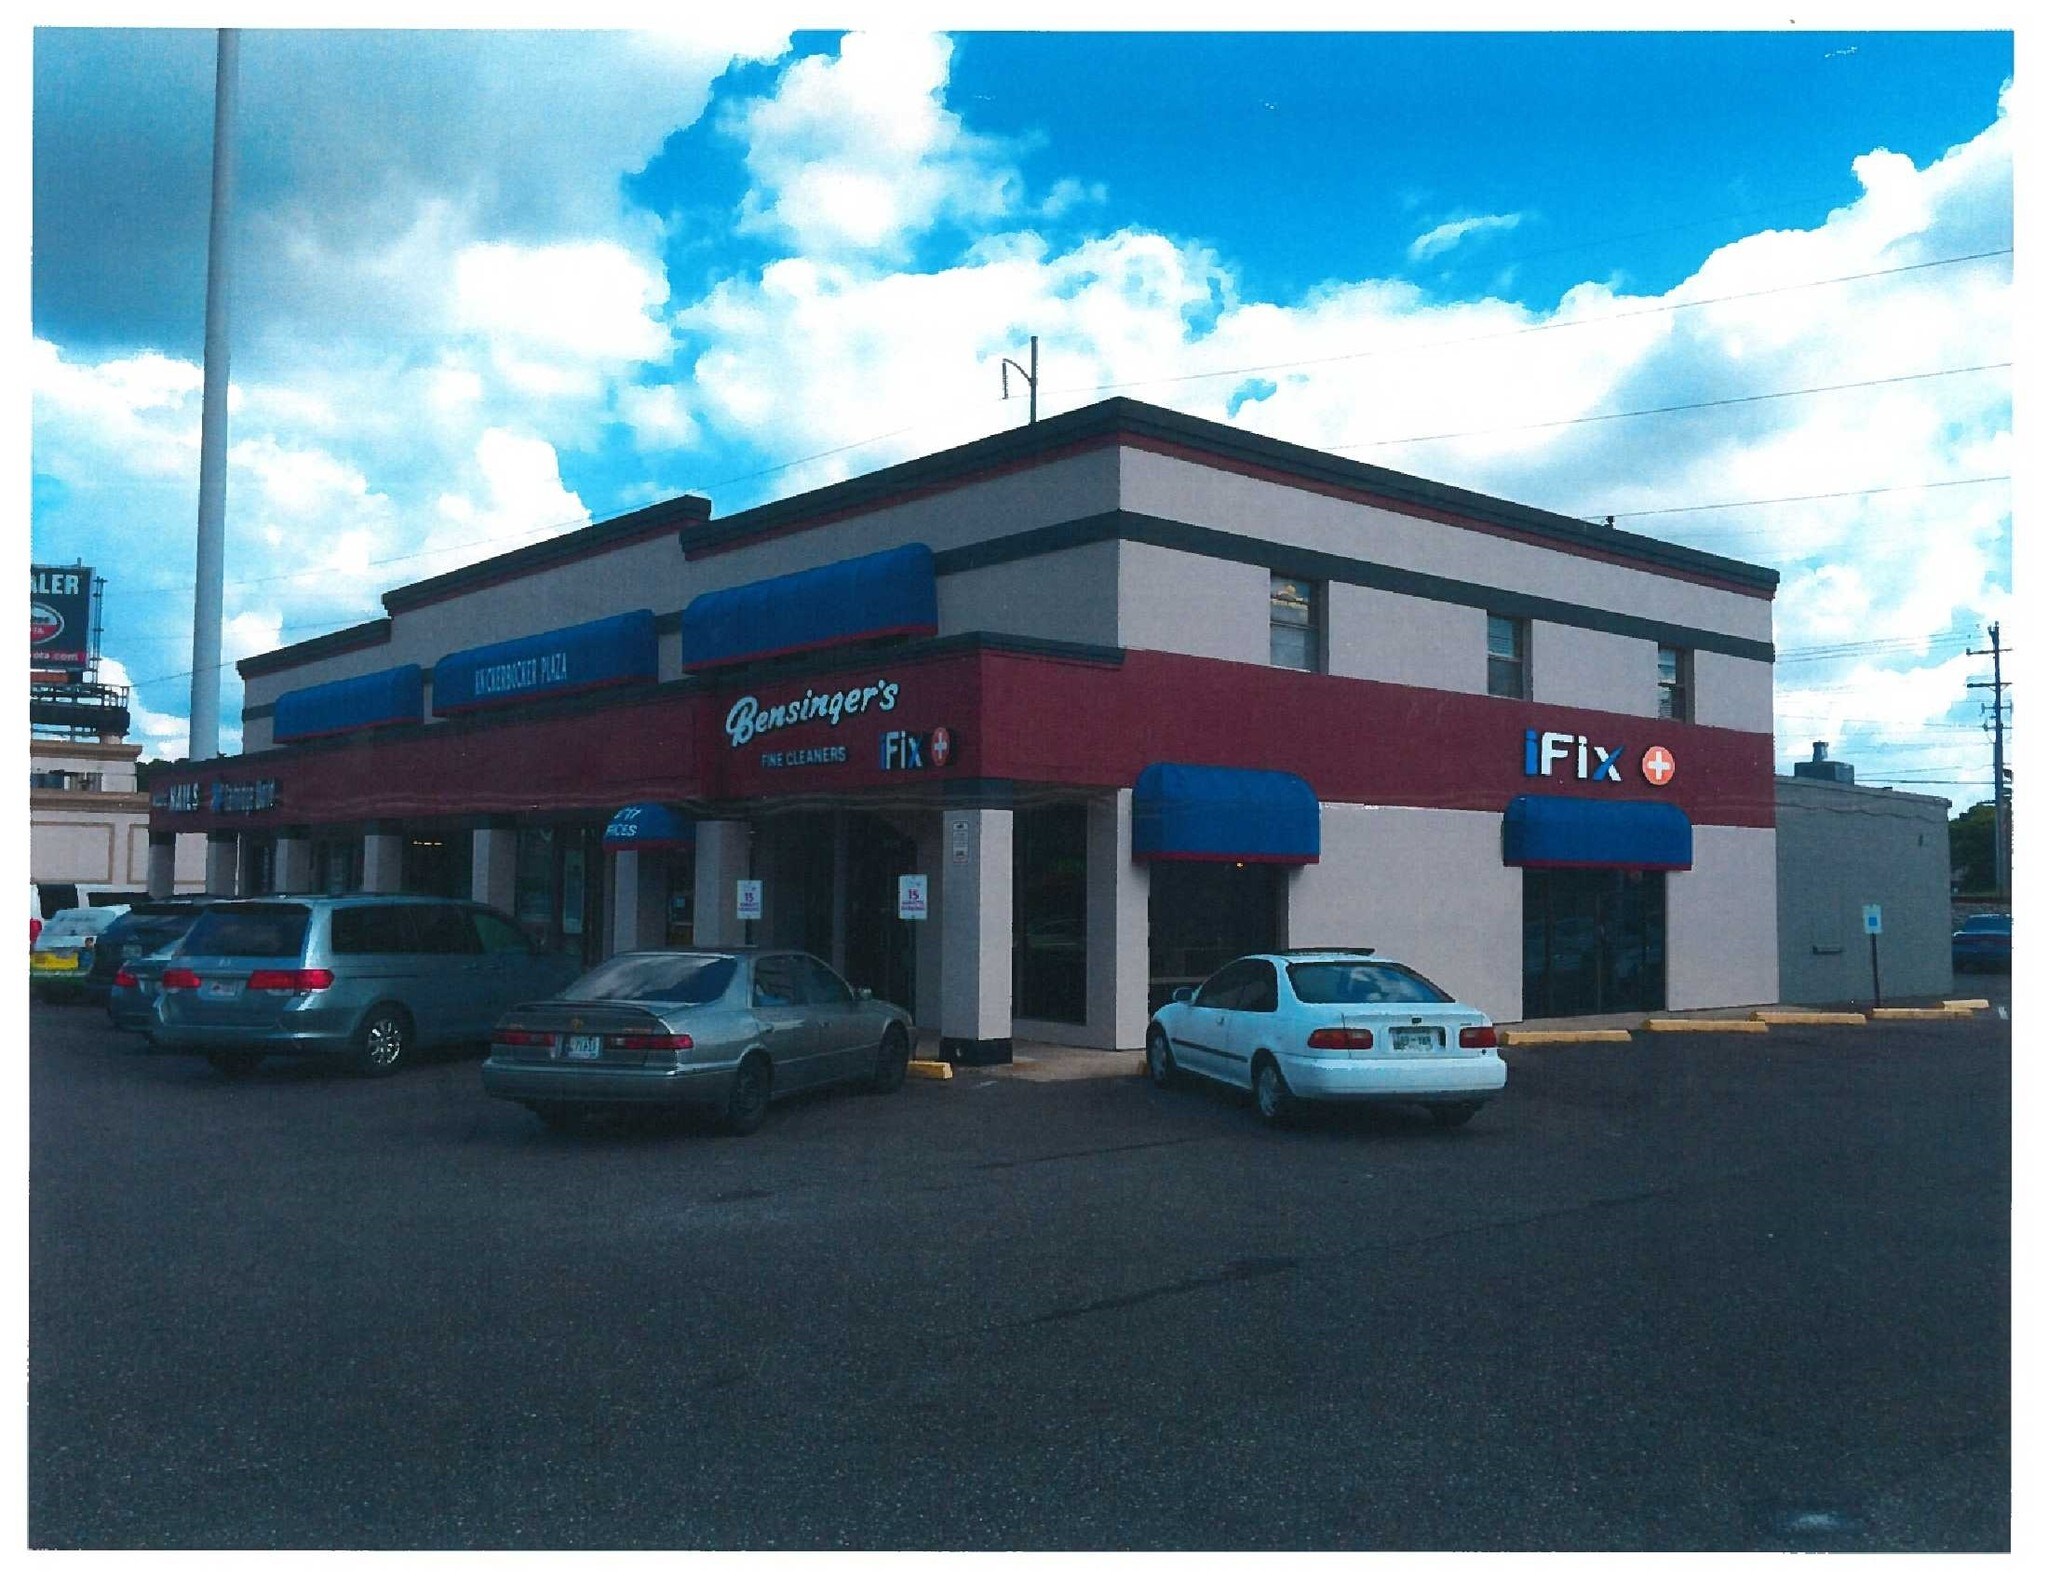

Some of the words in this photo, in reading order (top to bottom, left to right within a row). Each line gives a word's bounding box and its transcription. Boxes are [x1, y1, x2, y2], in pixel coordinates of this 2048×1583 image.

[541, 652, 567, 684] PLAZA
[725, 679, 899, 747] Bensinger's
[761, 752, 783, 768] FINE
[785, 746, 847, 767] CLEANERS
[880, 730, 923, 770] iFix
[1525, 727, 1626, 782] iFix
